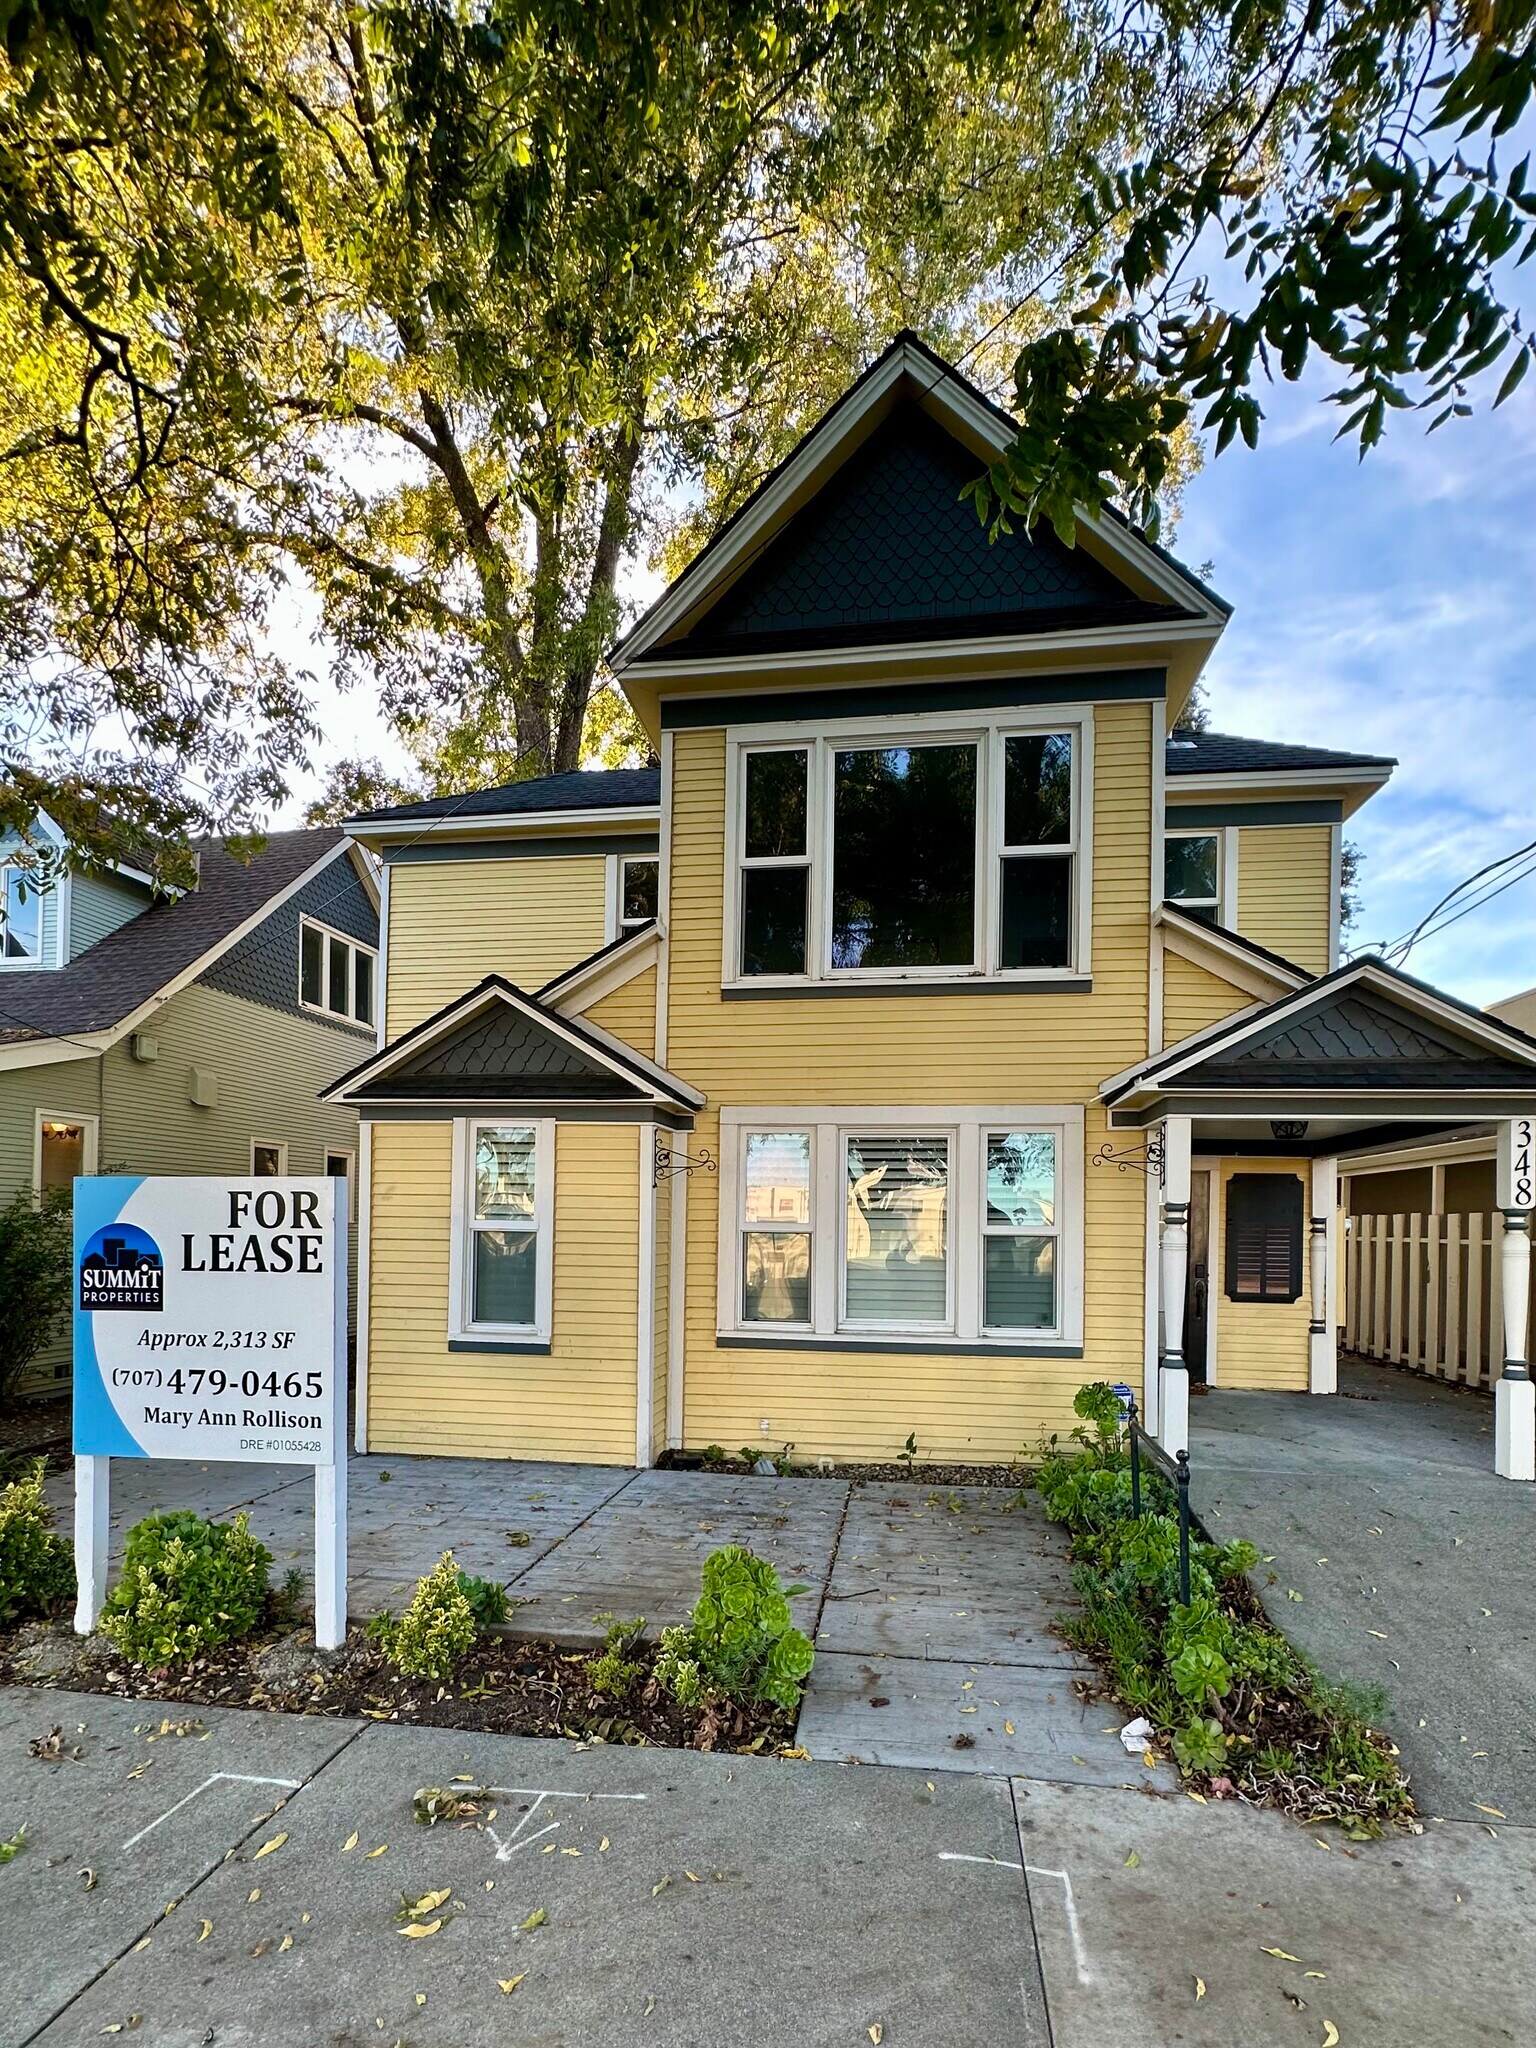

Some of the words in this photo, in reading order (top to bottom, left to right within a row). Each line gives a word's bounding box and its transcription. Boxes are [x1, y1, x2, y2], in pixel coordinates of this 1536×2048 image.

[1514, 1121, 1531, 1205] 348
[227, 1190, 323, 1229] FOR
[181, 1234, 323, 1273] LEASE
[83, 1291, 160, 1303] PROPERTIES
[137, 1329, 208, 1351] Approx
[212, 1330, 267, 1350] 2,313
[271, 1331, 296, 1349] SF
[112, 1368, 163, 1387] (707)
[166, 1368, 323, 1398] 479-0465
[144, 1407, 193, 1429] Mary
[198, 1408, 236, 1426] Ann
[241, 1410, 322, 1429] Rollison
[240, 1439, 264, 1450] DRE
[266, 1440, 321, 1452] #01055428
